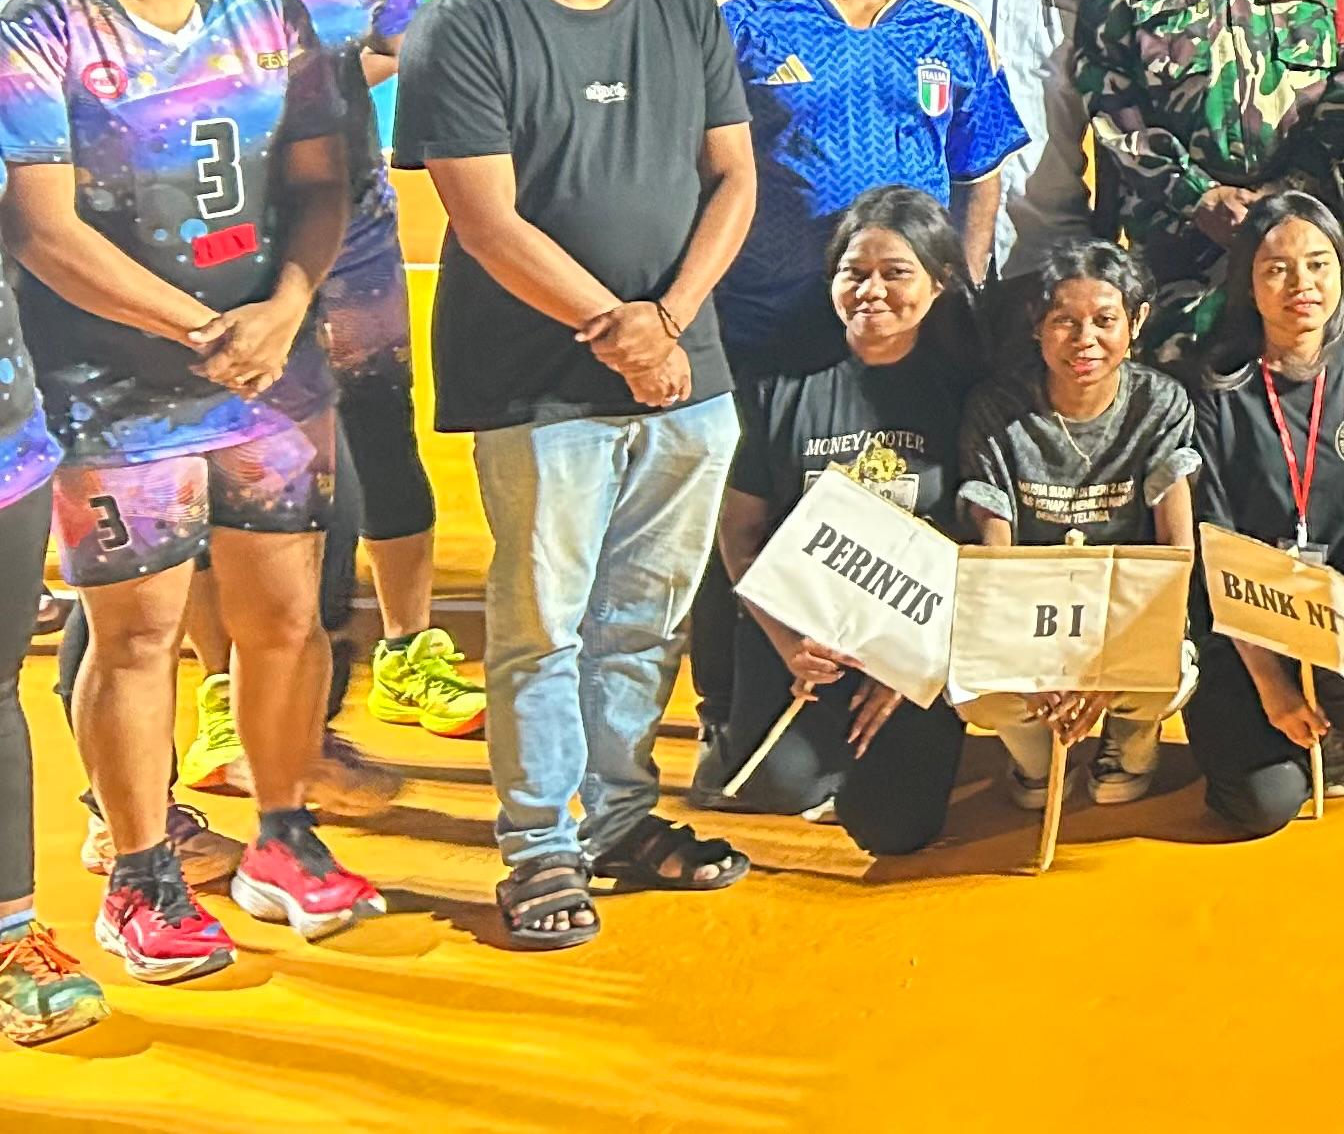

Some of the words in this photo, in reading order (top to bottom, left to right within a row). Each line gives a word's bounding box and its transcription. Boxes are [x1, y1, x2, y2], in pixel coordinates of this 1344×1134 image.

[190, 117, 245, 220] 3
[802, 430, 866, 456] MONEY
[88, 494, 132, 552] 3
[802, 522, 943, 625] PERINTIS
[1221, 570, 1301, 621] BANK
